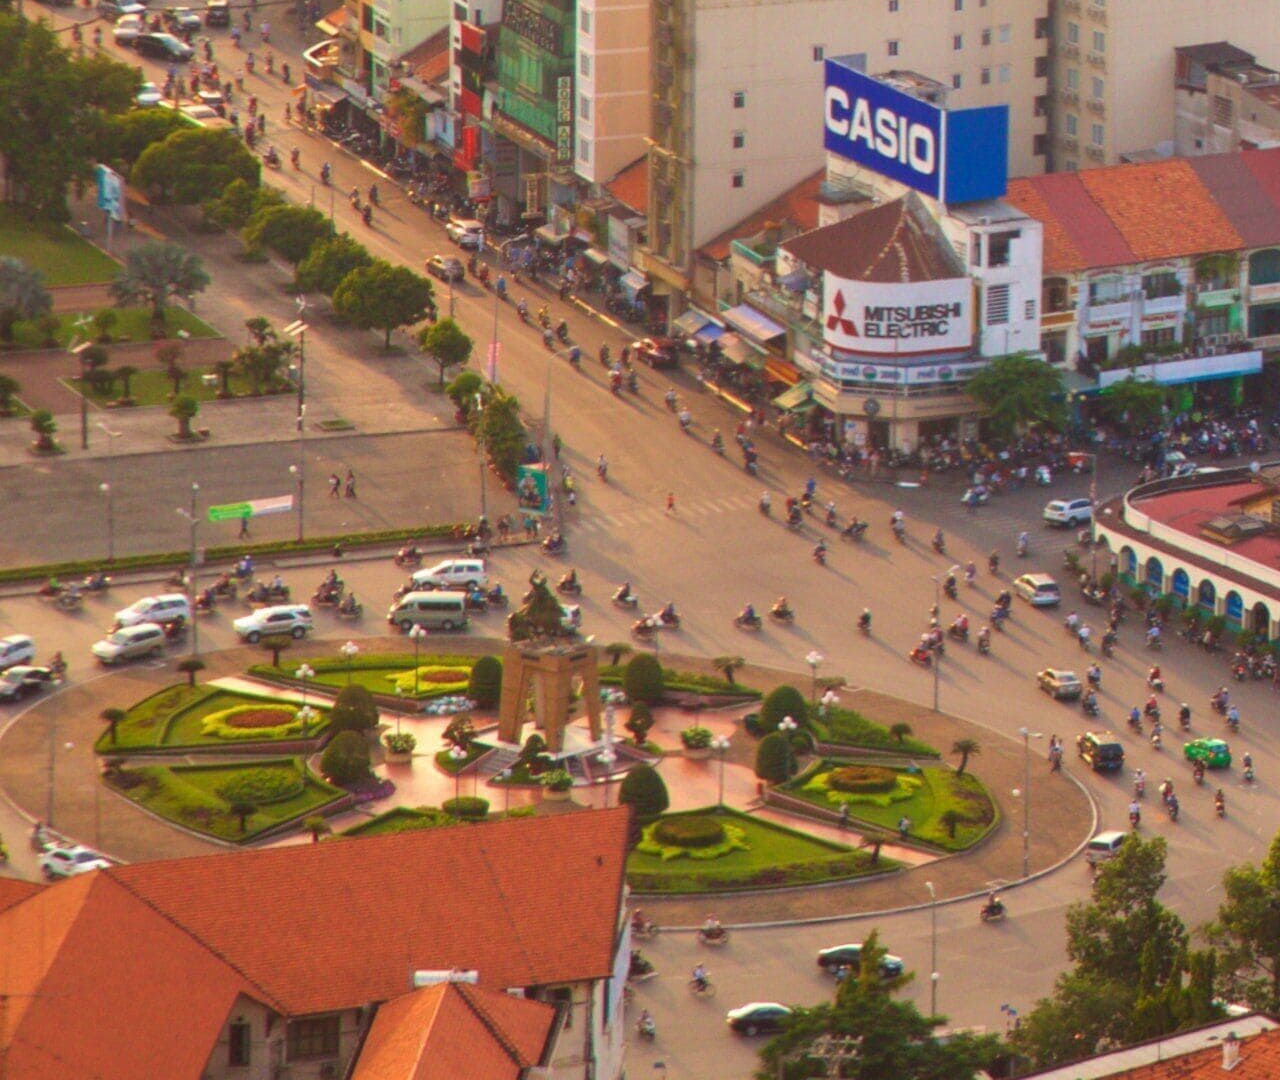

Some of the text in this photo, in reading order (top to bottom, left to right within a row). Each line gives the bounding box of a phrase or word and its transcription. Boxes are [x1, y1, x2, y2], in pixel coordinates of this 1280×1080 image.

[825, 85, 936, 176] CASIO
[864, 302, 961, 322] MITSUBISHI
[864, 319, 950, 338] ELECTRIC
